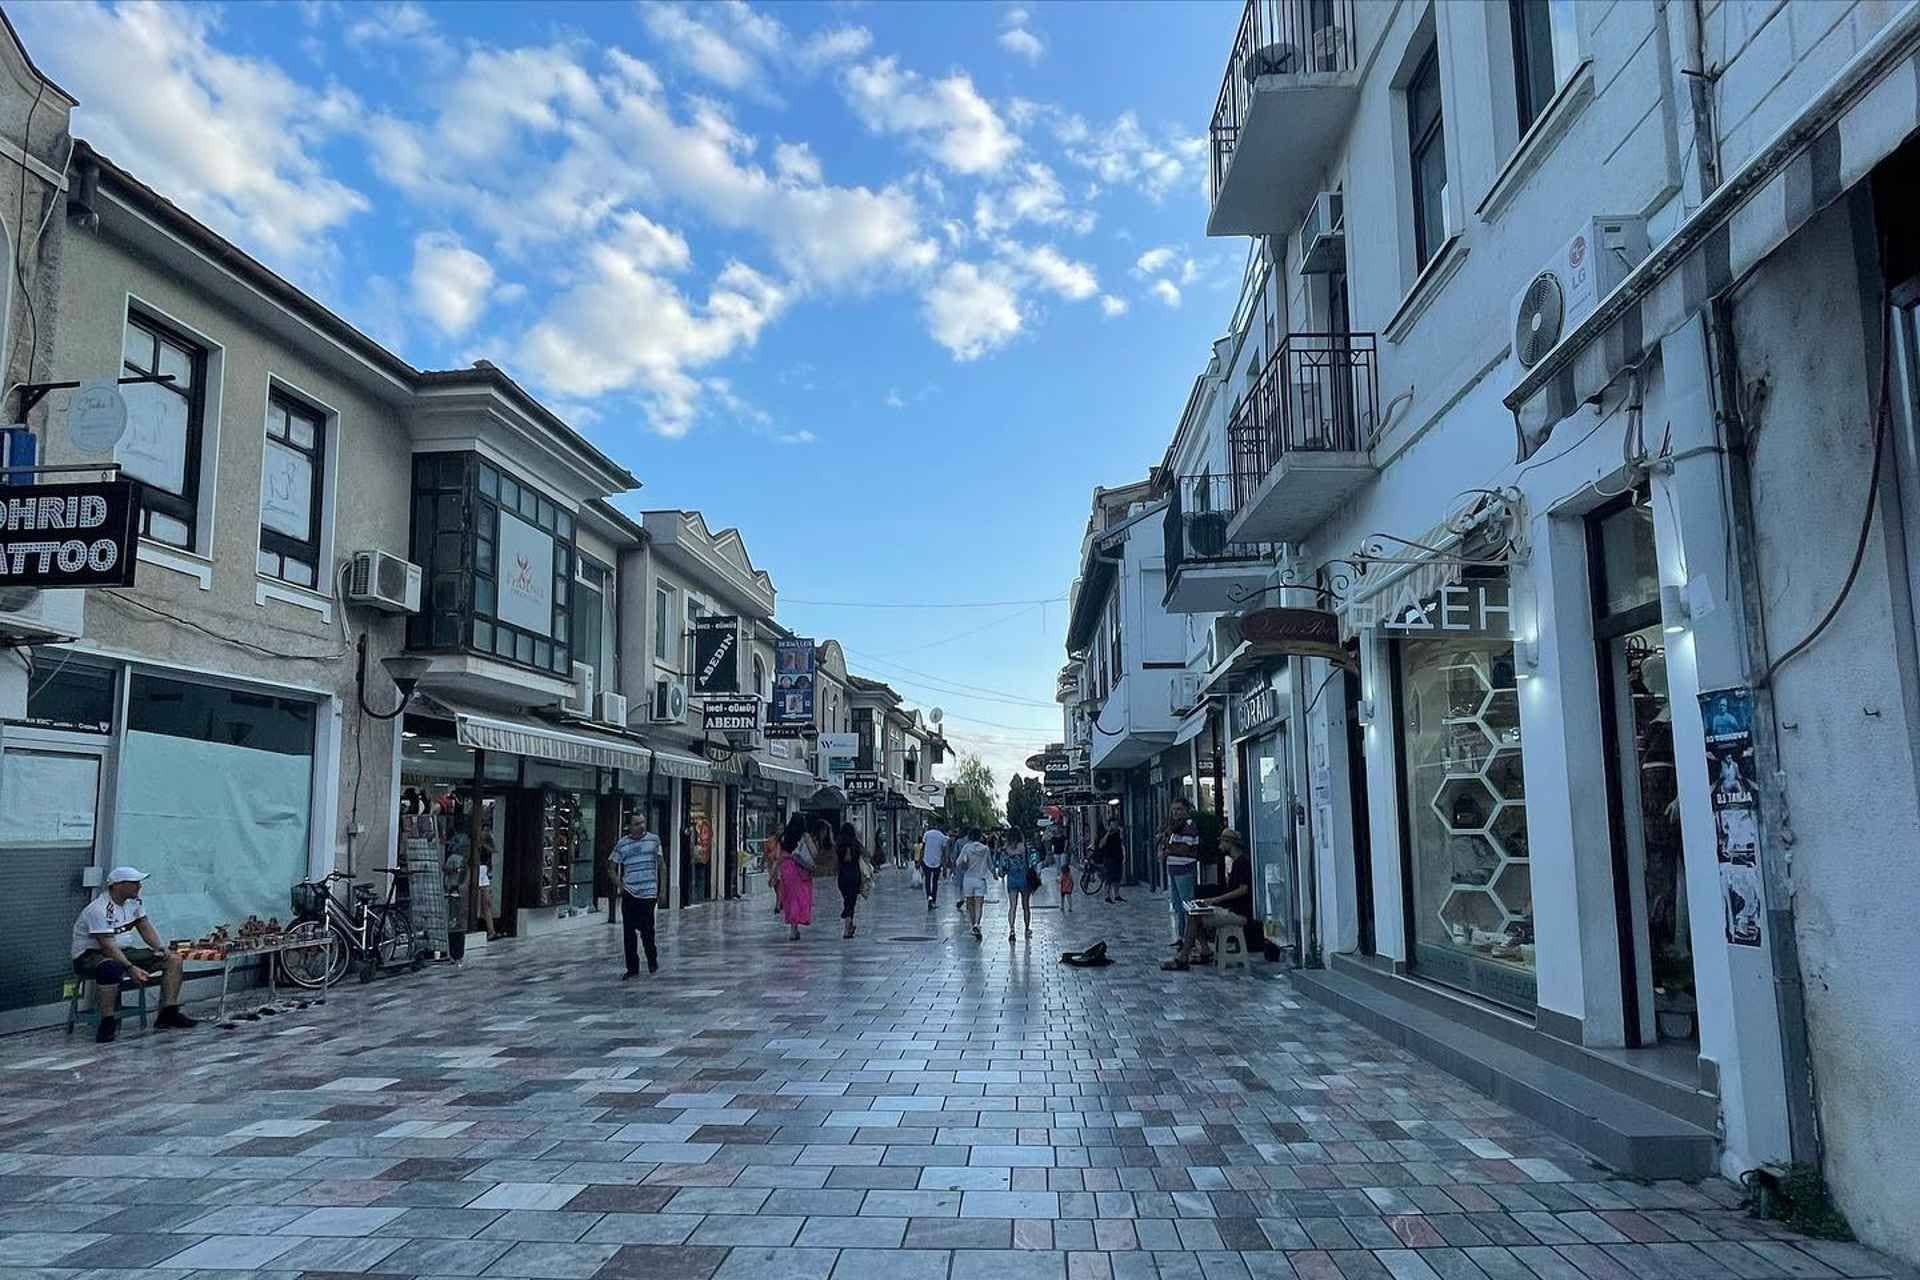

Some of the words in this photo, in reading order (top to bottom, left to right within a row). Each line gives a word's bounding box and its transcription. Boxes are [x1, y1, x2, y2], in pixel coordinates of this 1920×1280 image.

[1572, 268, 1585, 289] LG
[0, 495, 107, 530] HRID
[0, 539, 118, 574] TTOO
[699, 633, 734, 686] ABEDIN
[706, 716, 755, 729] ABEDIN
